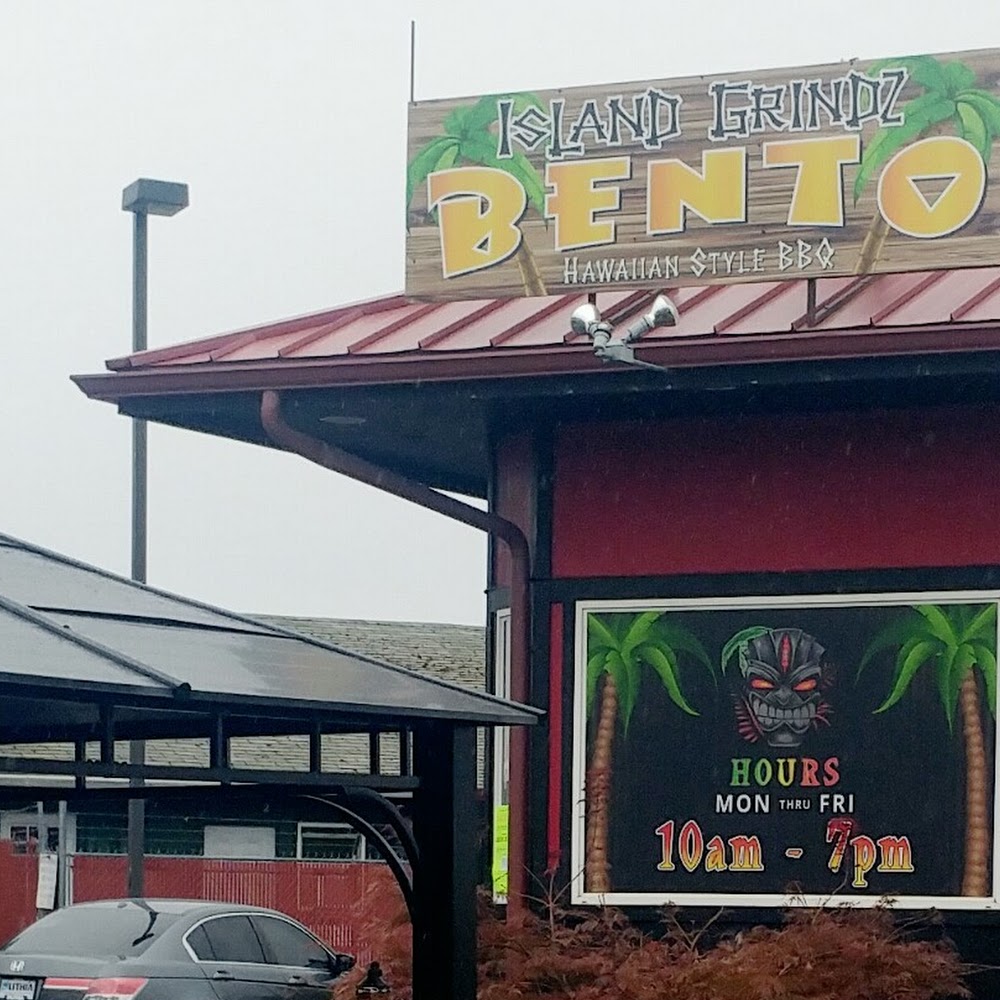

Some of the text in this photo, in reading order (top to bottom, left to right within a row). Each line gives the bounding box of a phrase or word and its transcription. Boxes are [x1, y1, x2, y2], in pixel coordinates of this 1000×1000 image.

[497, 67, 909, 159] ISLAND GRINDZ
[428, 135, 987, 279] BENTO
[563, 236, 835, 285] HAWAIIAN STYLE BBQ
[730, 757, 840, 787] HOURS
[715, 794, 855, 814] MON THRU FRI
[655, 819, 764, 872] 10am
[826, 818, 915, 888] 7pm
